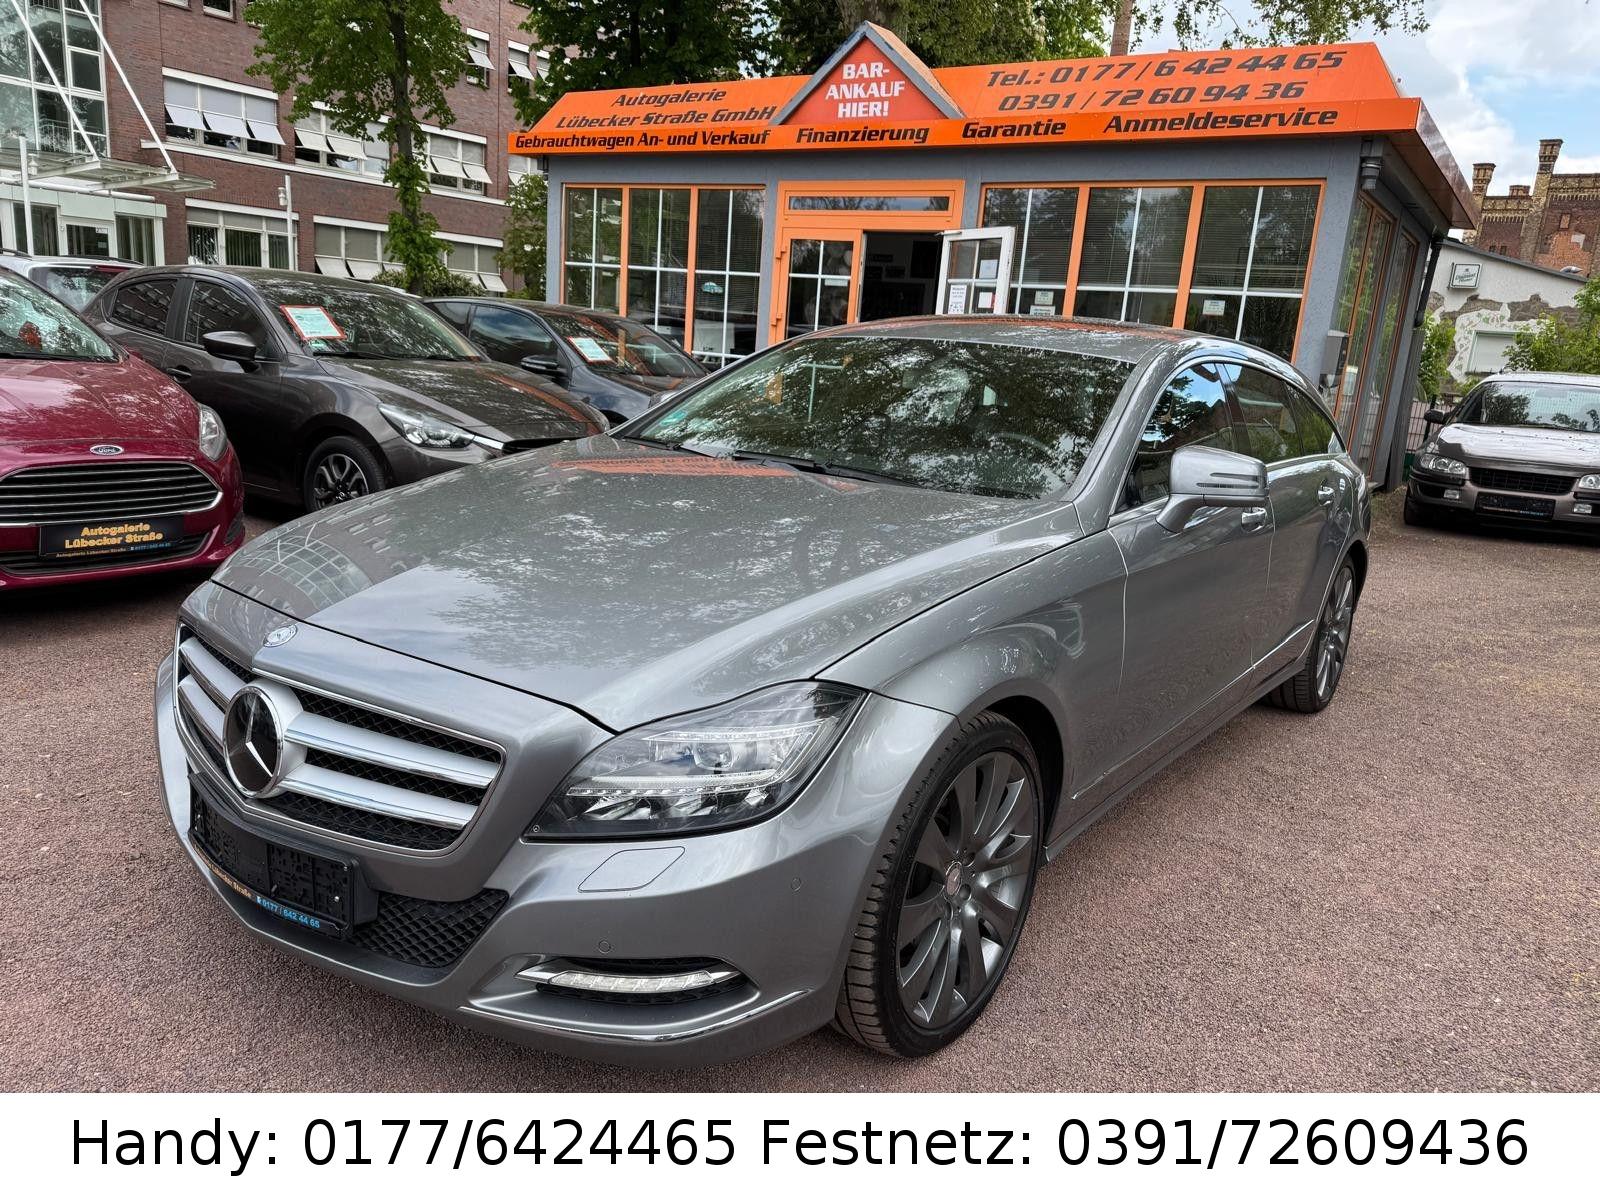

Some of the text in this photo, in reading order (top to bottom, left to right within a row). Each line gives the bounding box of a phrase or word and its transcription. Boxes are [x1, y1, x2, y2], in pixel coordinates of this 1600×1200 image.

[842, 62, 890, 79] BAR-
[987, 69, 1045, 87] Tel.:
[1050, 62, 1136, 83] 0177
[1154, 60, 1179, 76] 6
[1183, 57, 1232, 75] 42
[1237, 54, 1288, 72] 44
[1292, 51, 1347, 70] 65
[611, 88, 726, 107] Autogalerie
[825, 81, 905, 99] ANKAUF
[998, 93, 1077, 111] 0391
[1100, 89, 1143, 107] 72
[1148, 86, 1196, 104] 60
[1200, 84, 1250, 102] 94
[1255, 81, 1308, 99] 36
[555, 106, 777, 129] Lübecker Straße GmbH
[838, 101, 889, 118] HIER!
[516, 108, 1338, 149] Gebrauchtwagen An- und Verkauf Finanzierung Garantie Anmeldeservice
[81, 522, 150, 536] Autogalerie
[65, 536, 123, 549] Lübecker
[125, 531, 163, 543] Straße
[262, 899, 278, 912] 0177
[283, 909, 297, 921] 642
[309, 918, 320, 929] 65
